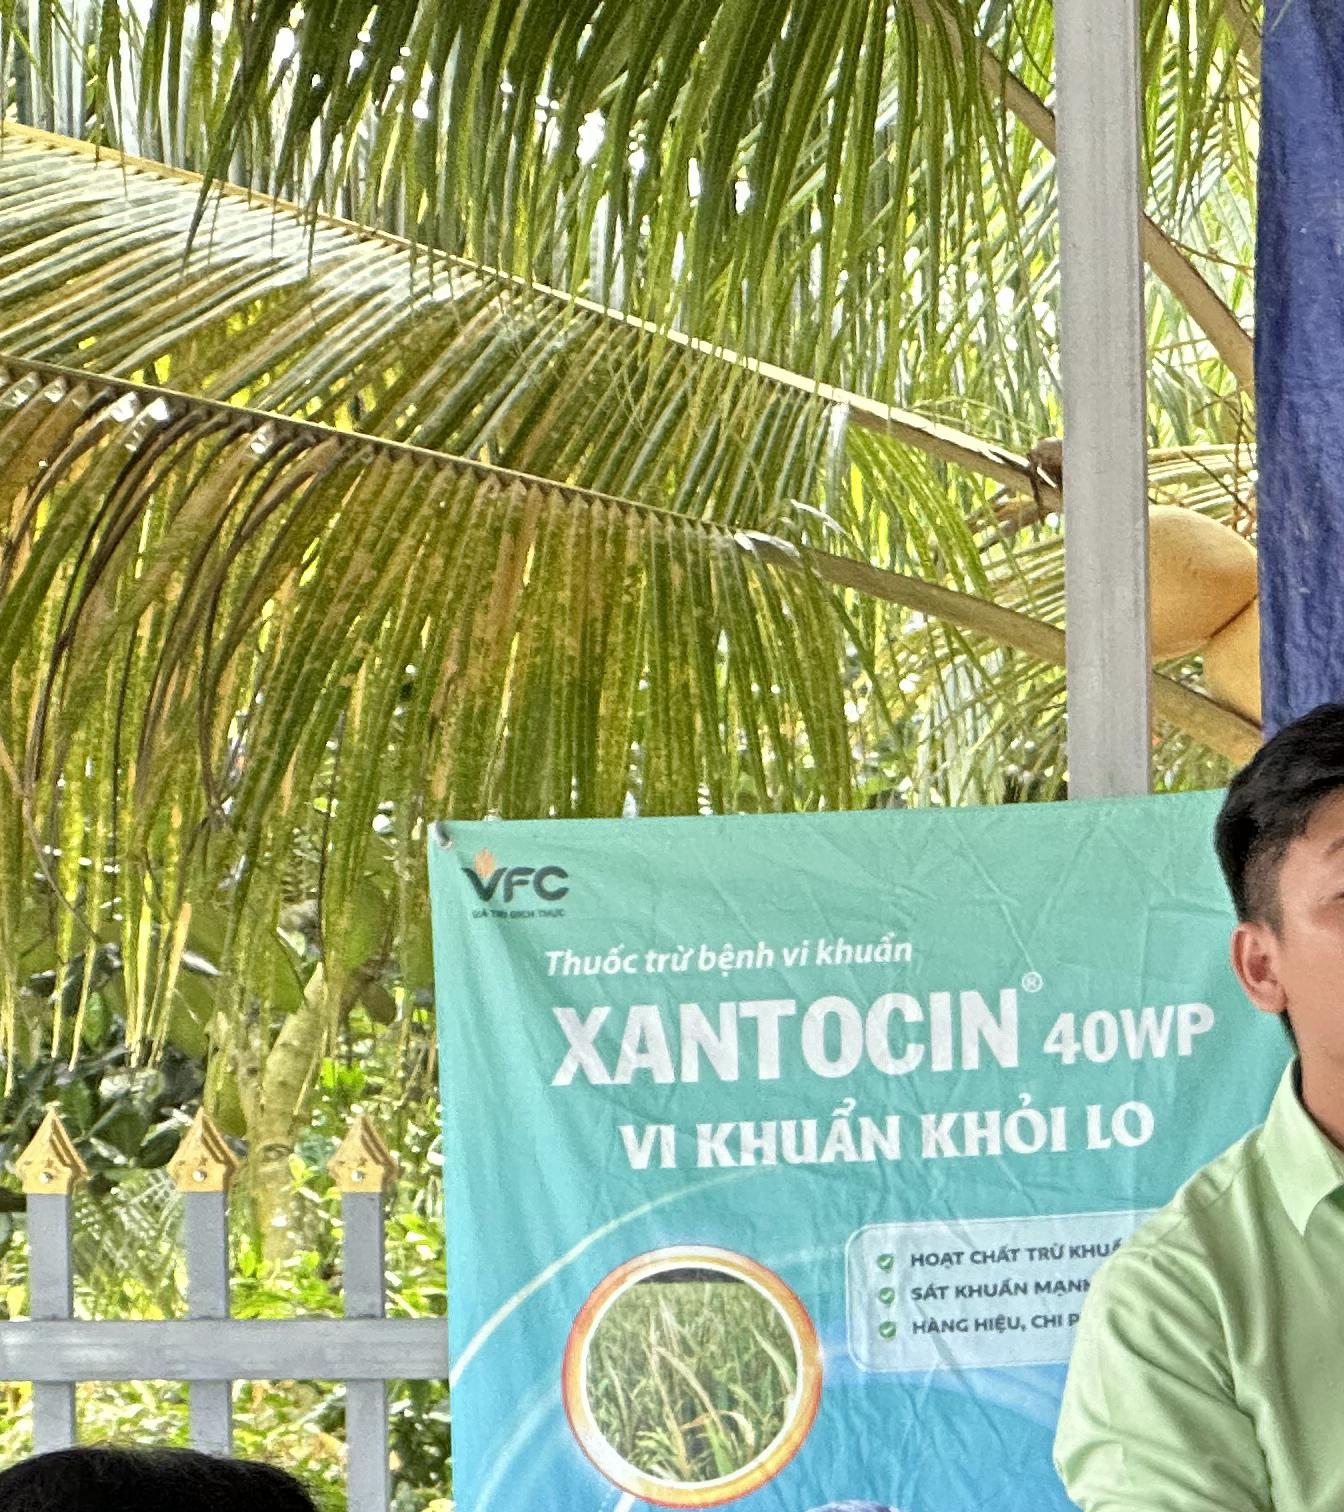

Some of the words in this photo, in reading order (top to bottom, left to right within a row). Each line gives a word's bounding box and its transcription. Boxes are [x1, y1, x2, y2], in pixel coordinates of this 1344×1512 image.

[461, 866, 569, 902] VFC
[545, 944, 637, 976] Thuốc
[645, 946, 694, 973] trừ
[698, 941, 774, 977] bệnh
[783, 939, 809, 967] vi
[816, 932, 913, 966] khuẩn
[1043, 1003, 1215, 1065] 40WP
[619, 1124, 676, 1170] VI
[698, 1098, 900, 1169] KHUẨN
[921, 1093, 1069, 1160] KHỎI
[1086, 1101, 1155, 1149] LO
[911, 1251, 965, 1269] HOẠT
[970, 1246, 1021, 1263] CHẤT
[911, 1285, 949, 1301] SÁT
[912, 1316, 969, 1335] HÀNG
[1031, 1313, 1063, 1328] CHI
